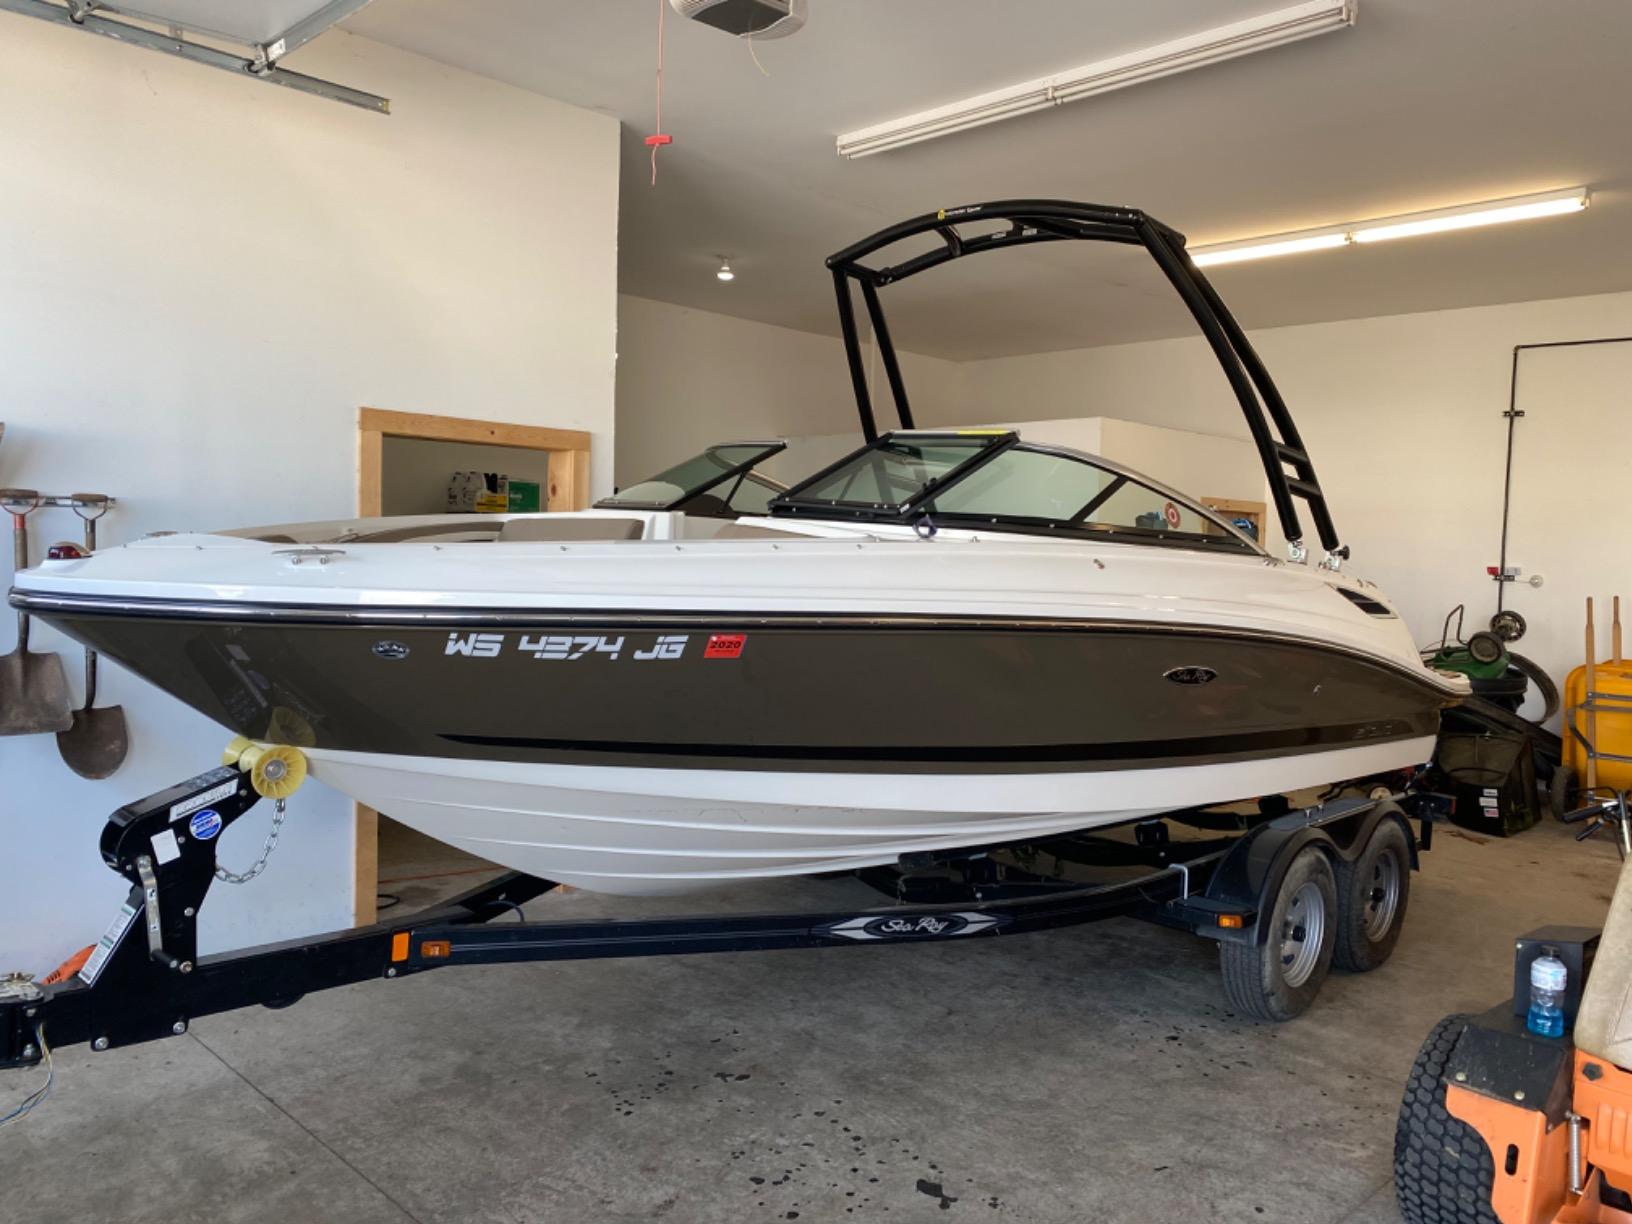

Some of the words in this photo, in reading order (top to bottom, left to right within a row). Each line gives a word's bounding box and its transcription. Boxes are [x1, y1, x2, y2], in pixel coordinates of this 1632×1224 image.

[444, 632, 505, 657] WS
[518, 635, 625, 660] 4374
[633, 634, 689, 660] JG
[708, 639, 742, 649] 2020
[881, 919, 914, 933] Sea
[914, 916, 949, 934] Ray
